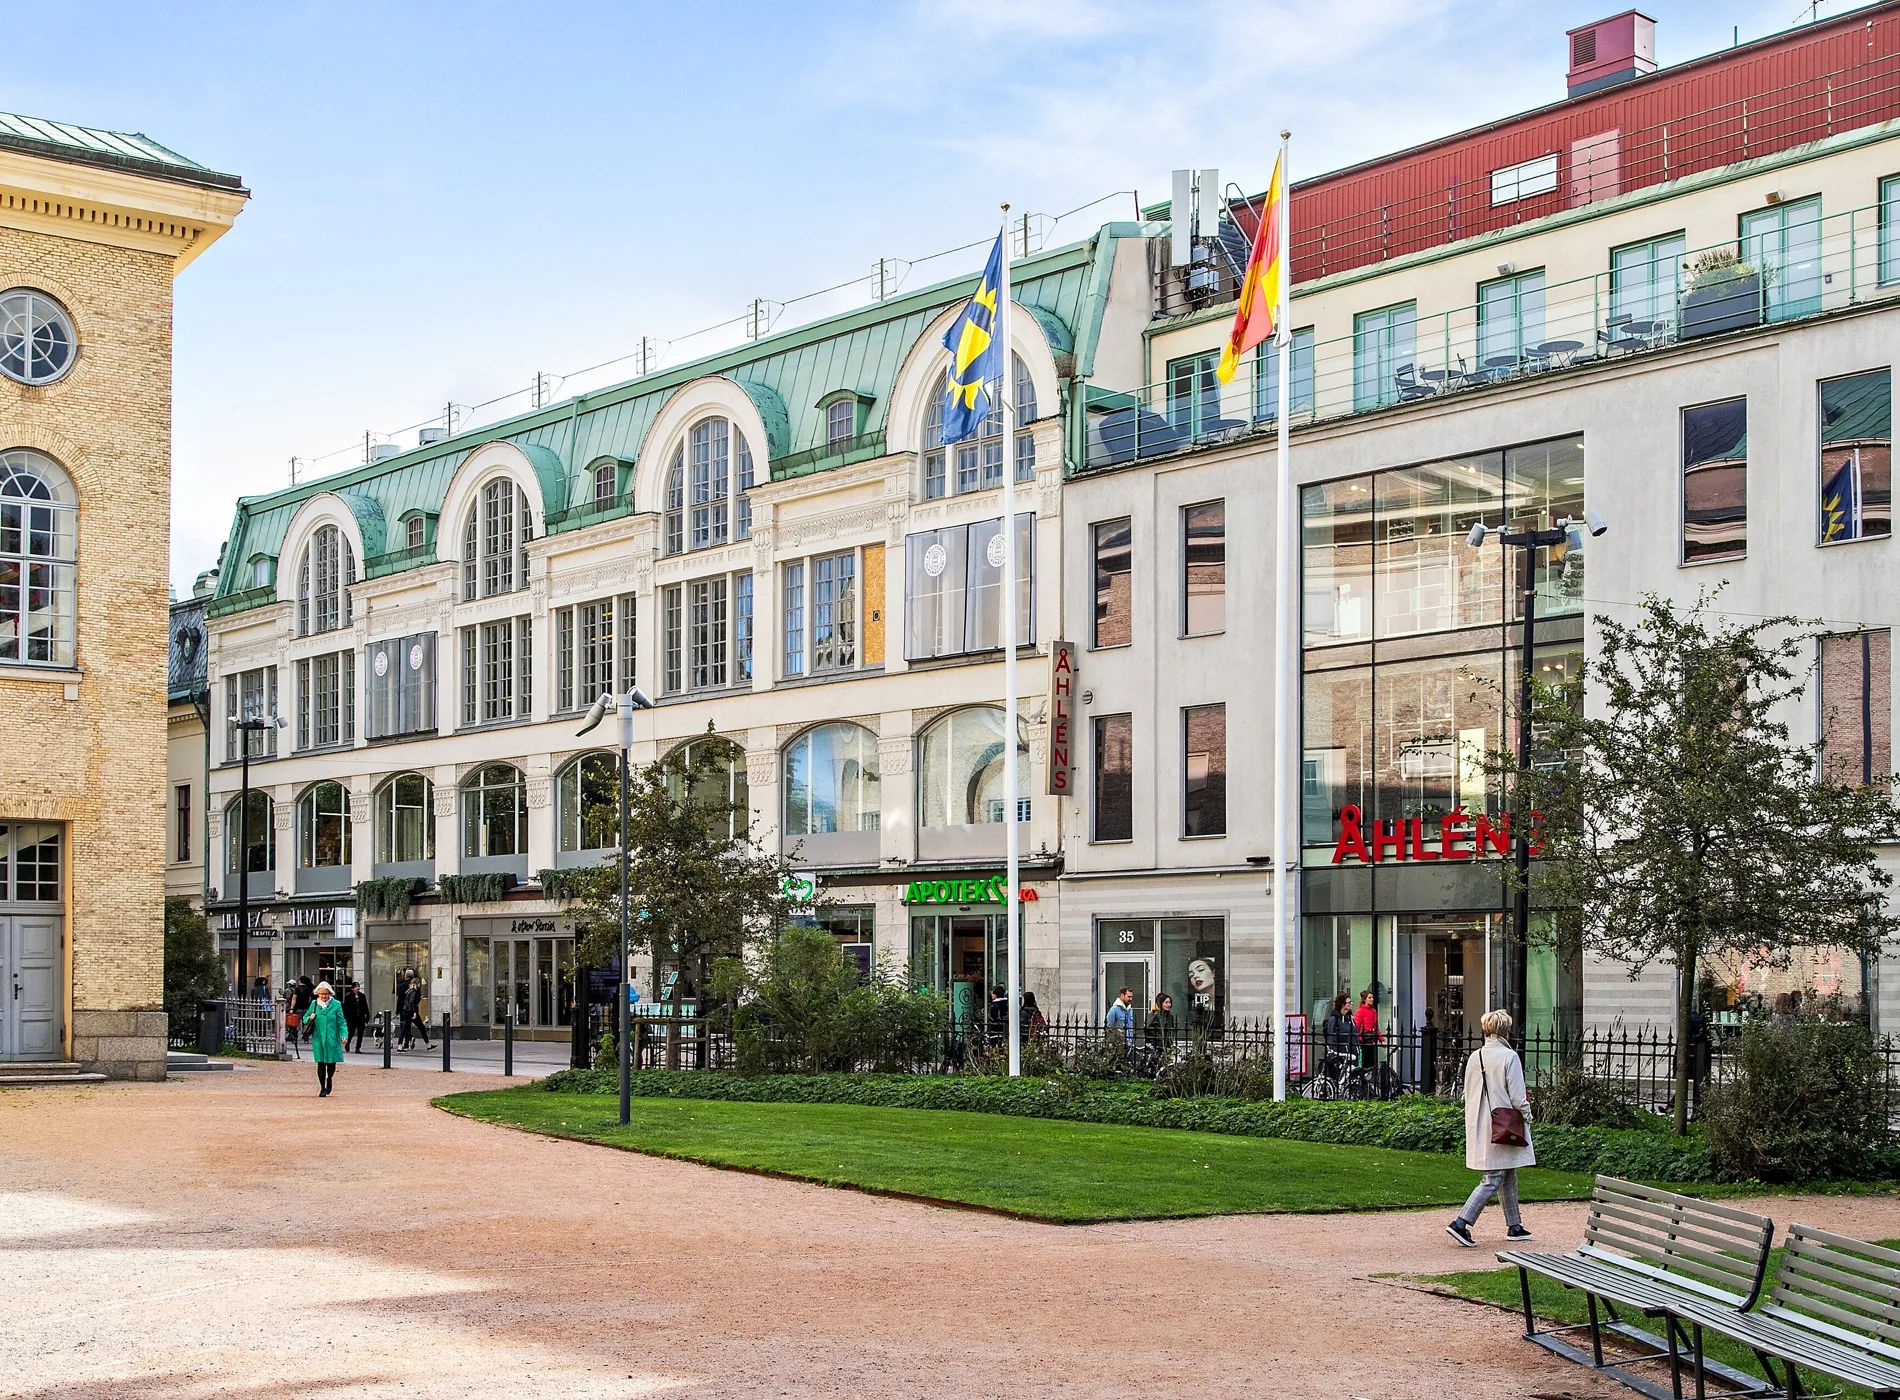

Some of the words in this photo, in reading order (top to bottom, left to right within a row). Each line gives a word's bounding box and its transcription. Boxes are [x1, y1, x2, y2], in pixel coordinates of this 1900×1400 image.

[1054, 648, 1071, 790] ÅHLÉNS
[906, 880, 990, 904] APOTEK
[292, 908, 335, 926] HEMTEX
[1118, 930, 1134, 943] 35
[1195, 995, 1210, 1005] LIP
